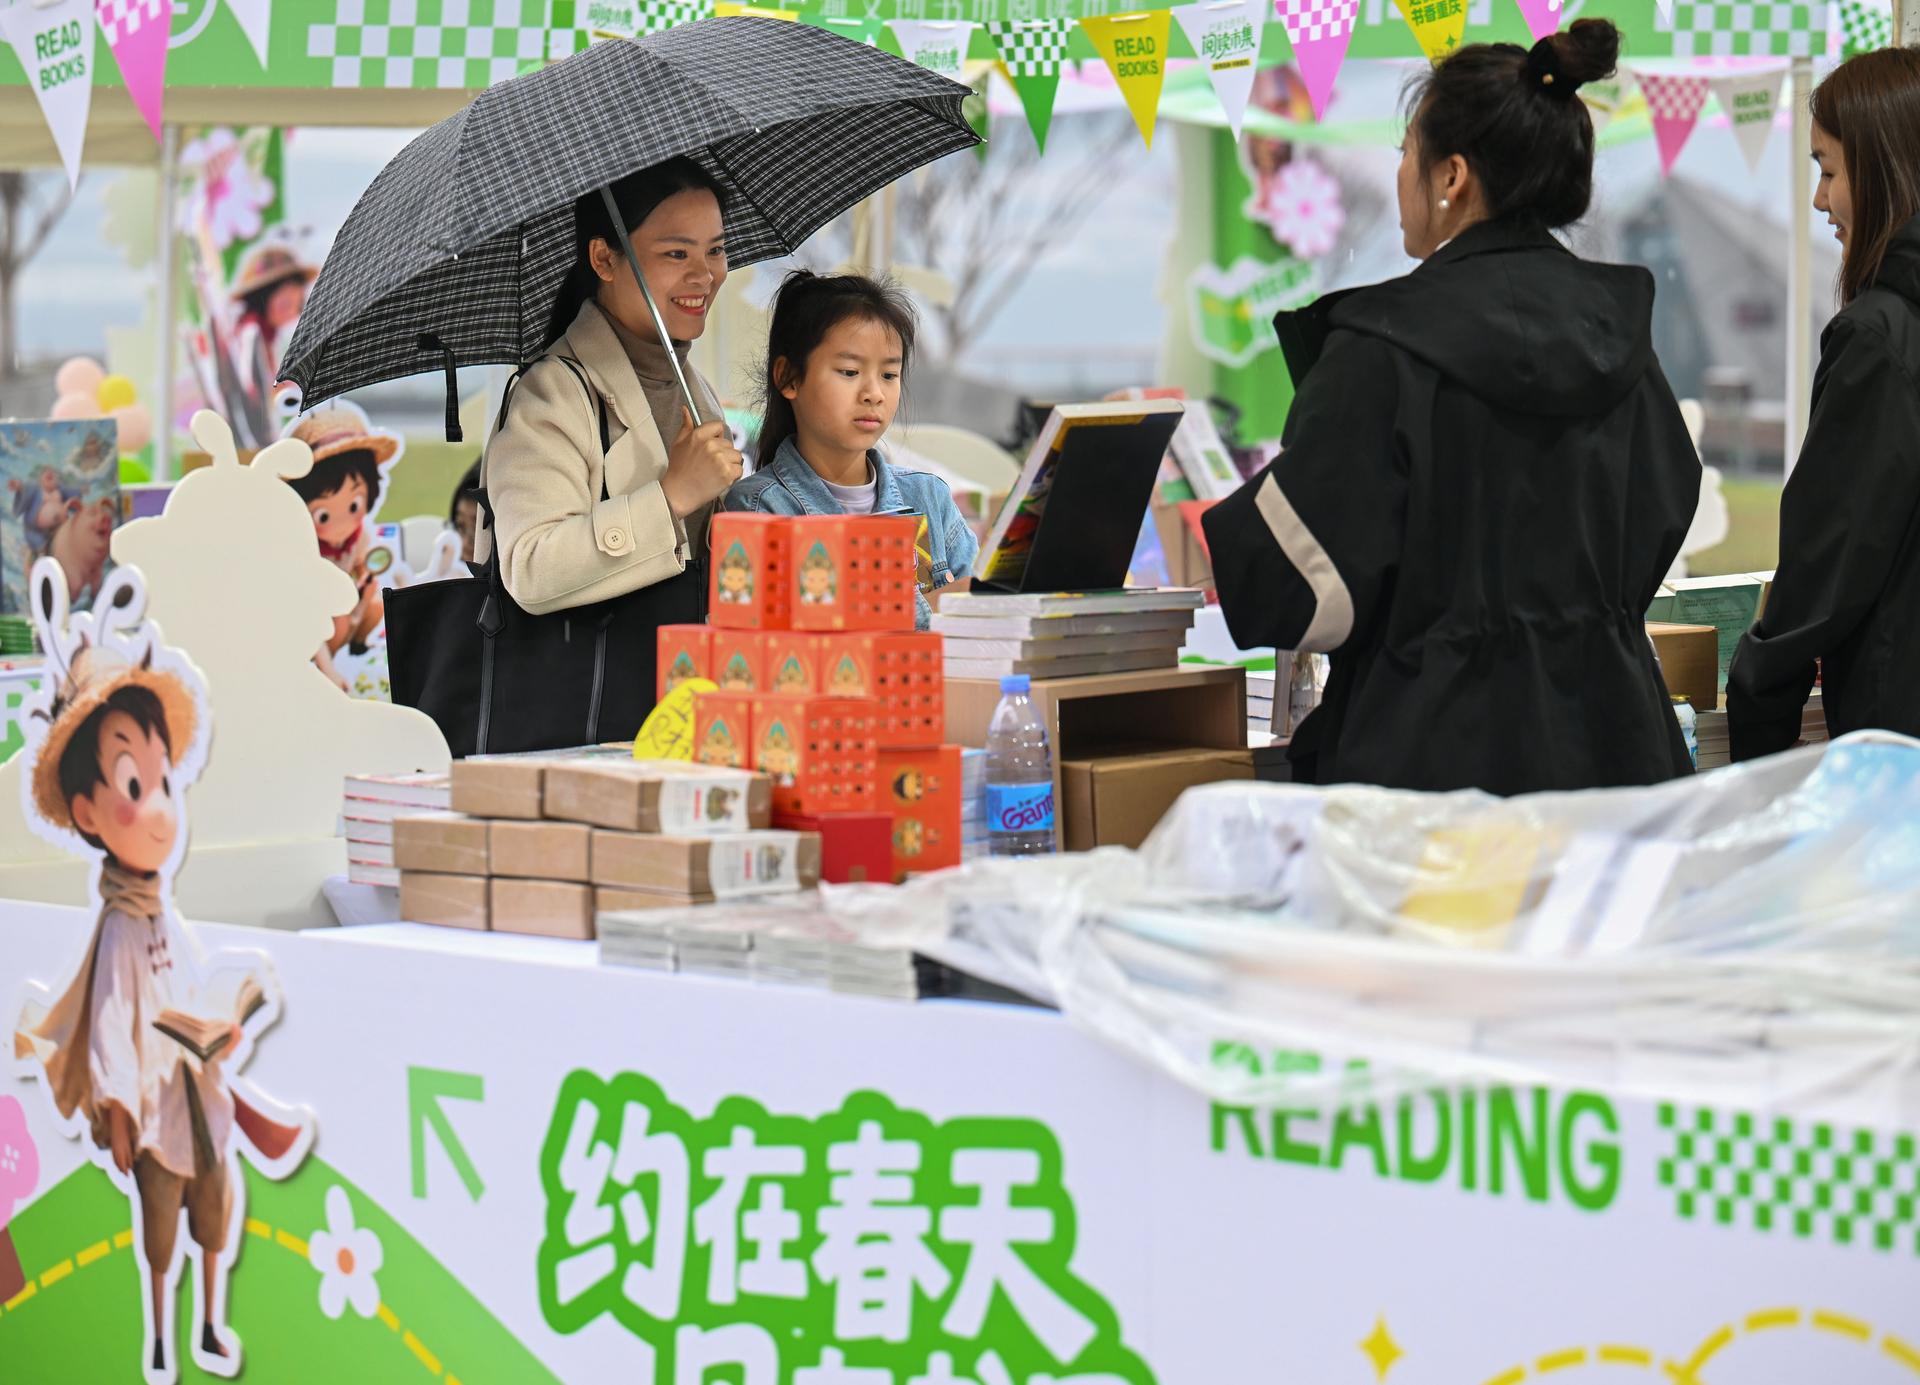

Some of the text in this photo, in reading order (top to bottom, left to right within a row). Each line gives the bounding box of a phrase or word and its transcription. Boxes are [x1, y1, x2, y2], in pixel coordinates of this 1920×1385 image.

[1411, 0, 1462, 26] 书香重庆
[36, 20, 81, 60] READ
[1114, 35, 1155, 57] READ
[1202, 22, 1255, 59] 阅读市集
[40, 53, 86, 90] BOOKS
[1117, 59, 1159, 77] BOOKS
[1209, 1039, 1620, 1213] READING
[555, 1097, 1101, 1366] 约在春天
